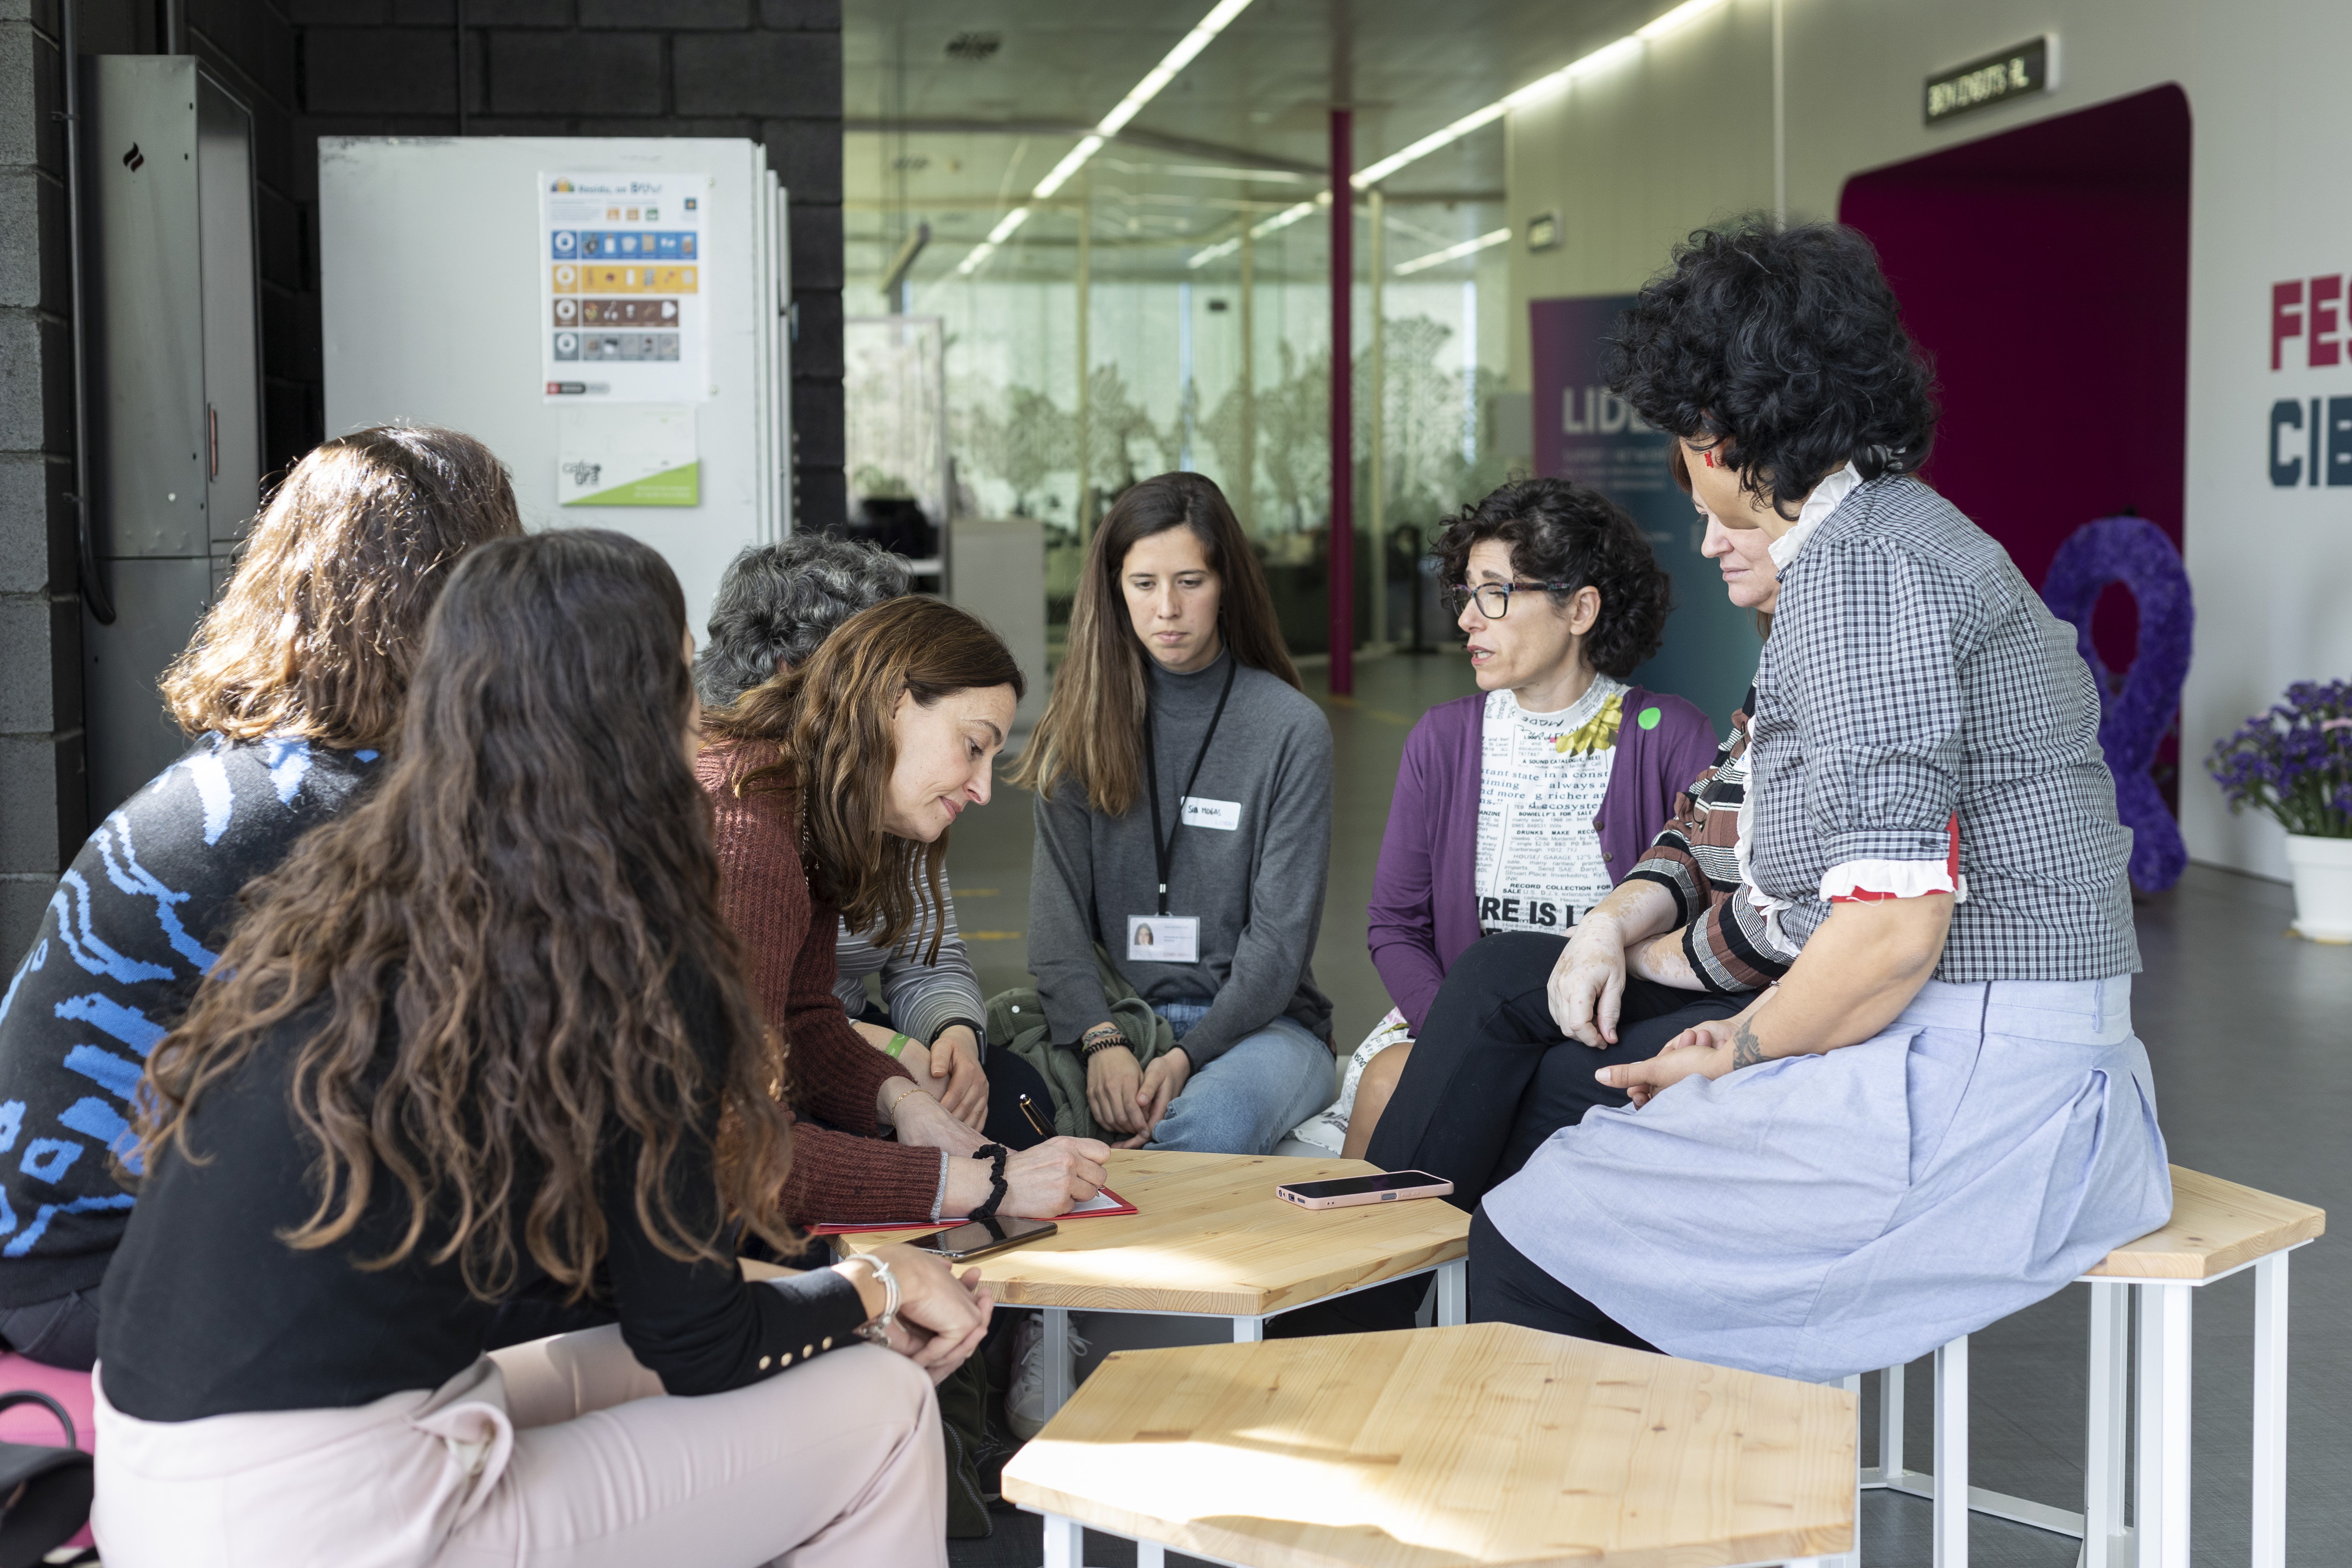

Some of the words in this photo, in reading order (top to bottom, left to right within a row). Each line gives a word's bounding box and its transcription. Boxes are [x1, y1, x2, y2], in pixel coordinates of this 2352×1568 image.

[2270, 273, 2352, 371] FE
[2269, 395, 2352, 490] CIB
[1512, 772, 1540, 781] state
[1549, 782, 1595, 790] always
[1542, 803, 1602, 811] ecosyste
[1530, 901, 1556, 927] IS
[1566, 906, 1595, 930] L
